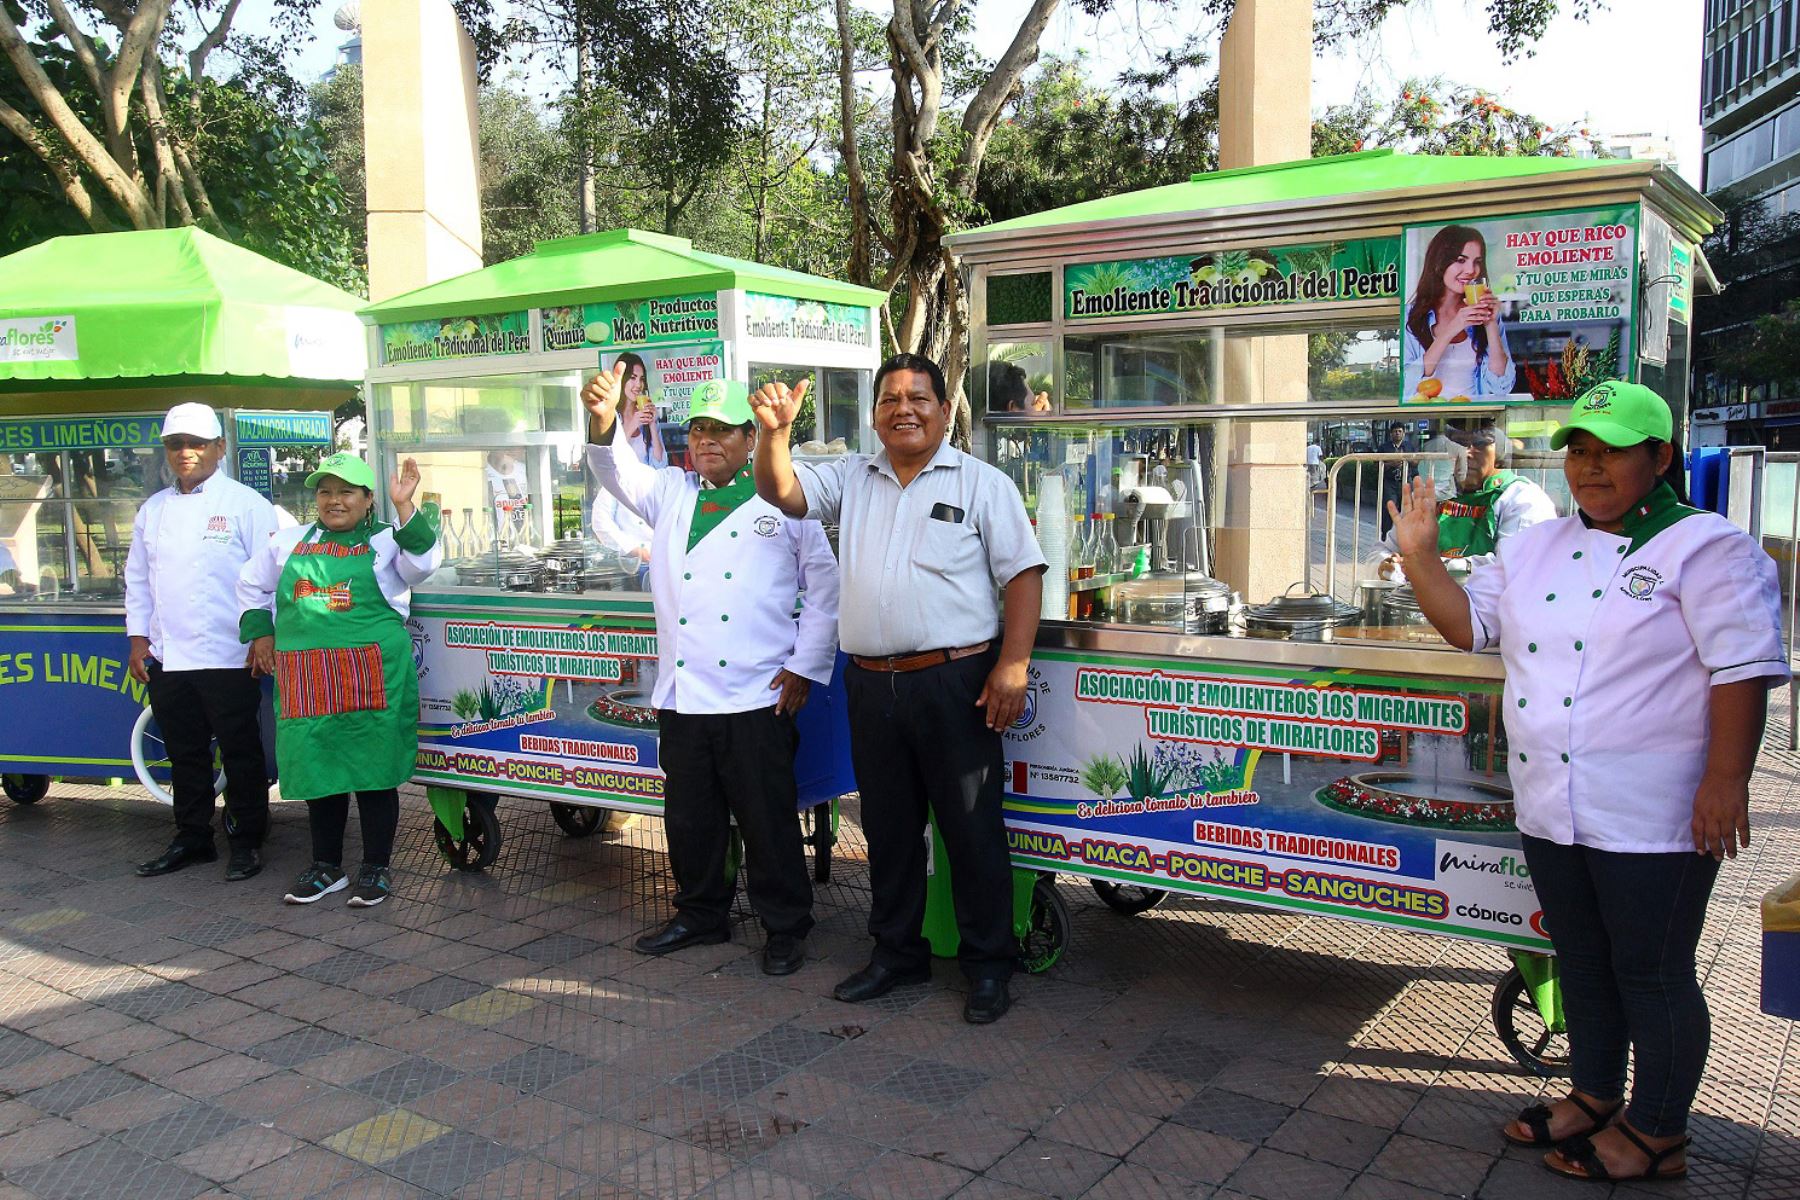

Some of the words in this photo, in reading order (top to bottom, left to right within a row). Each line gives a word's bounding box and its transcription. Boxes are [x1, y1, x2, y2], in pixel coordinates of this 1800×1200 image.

[1506, 231, 1542, 248] HAY
[1545, 229, 1580, 247] QUE
[1585, 225, 1627, 241] RICO
[1517, 247, 1614, 267] EMOLIENTE
[1072, 286, 1171, 315] Emoliente
[1175, 273, 1298, 307] Tradicional
[1303, 270, 1336, 298] del
[1343, 264, 1399, 296] Perú
[1516, 274, 1524, 286] Y
[1526, 273, 1541, 285] TU
[1544, 271, 1568, 287] QUE
[1570, 270, 1587, 283] ME
[651, 298, 717, 316] Productos
[1531, 291, 1555, 306] QUE
[1521, 310, 1551, 322] PARA
[1557, 306, 1620, 320] PROBARLO
[613, 318, 646, 342] Maca
[650, 315, 718, 335] Nutritivos
[791, 317, 835, 342] Tradicional
[386, 340, 433, 362] Emoliente
[434, 333, 489, 357] Tradicional
[491, 331, 505, 352] del
[656, 358, 675, 371] HAY
[676, 357, 696, 370] QUE
[697, 355, 719, 367] RICO
[663, 370, 713, 384] EMOLIENTE
[678, 386, 692, 398] QUE
[41, 420, 142, 447] LIMEÑOS
[239, 418, 292, 439] MAZAMORRA
[293, 417, 327, 439] MORADA
[447, 625, 501, 646] ASOCIACIÓN
[502, 628, 515, 647] DE
[516, 630, 586, 651] EMOLIENTEROS
[587, 633, 606, 652] LOS
[489, 650, 544, 673] TURÍSTICOS
[546, 656, 558, 674] DE
[560, 658, 620, 679] MIRAFLORES
[1079, 673, 1172, 703] ASOCIACIÓN
[1176, 682, 1195, 705] DE
[1198, 684, 1320, 716] EMOLIENTEROS
[1322, 692, 1354, 719] LOS
[1358, 696, 1463, 730] MIGRANTES
[1149, 710, 1242, 743] TURÍSTICOS
[1246, 720, 1266, 744] DE
[1270, 722, 1376, 755] MIRAFLORES
[521, 736, 560, 754] BEBIDAS
[561, 740, 637, 761] TRADICIONALES
[457, 756, 496, 774] MACA
[508, 764, 563, 782] PONCHE
[575, 771, 664, 794] SANGUCHES
[1041, 772, 1080, 784] 13587732
[1077, 803, 1092, 818] Es
[1094, 801, 1143, 816] deliciosa
[1205, 790, 1258, 806] también
[1196, 822, 1263, 849] BEBIDAS
[1267, 832, 1397, 868] TRADICIONALES
[1086, 844, 1150, 869] MACA
[1170, 855, 1264, 887] PONCHE
[1287, 874, 1443, 916] SANGUCHES
[1455, 903, 1523, 926] CÓDIGO
